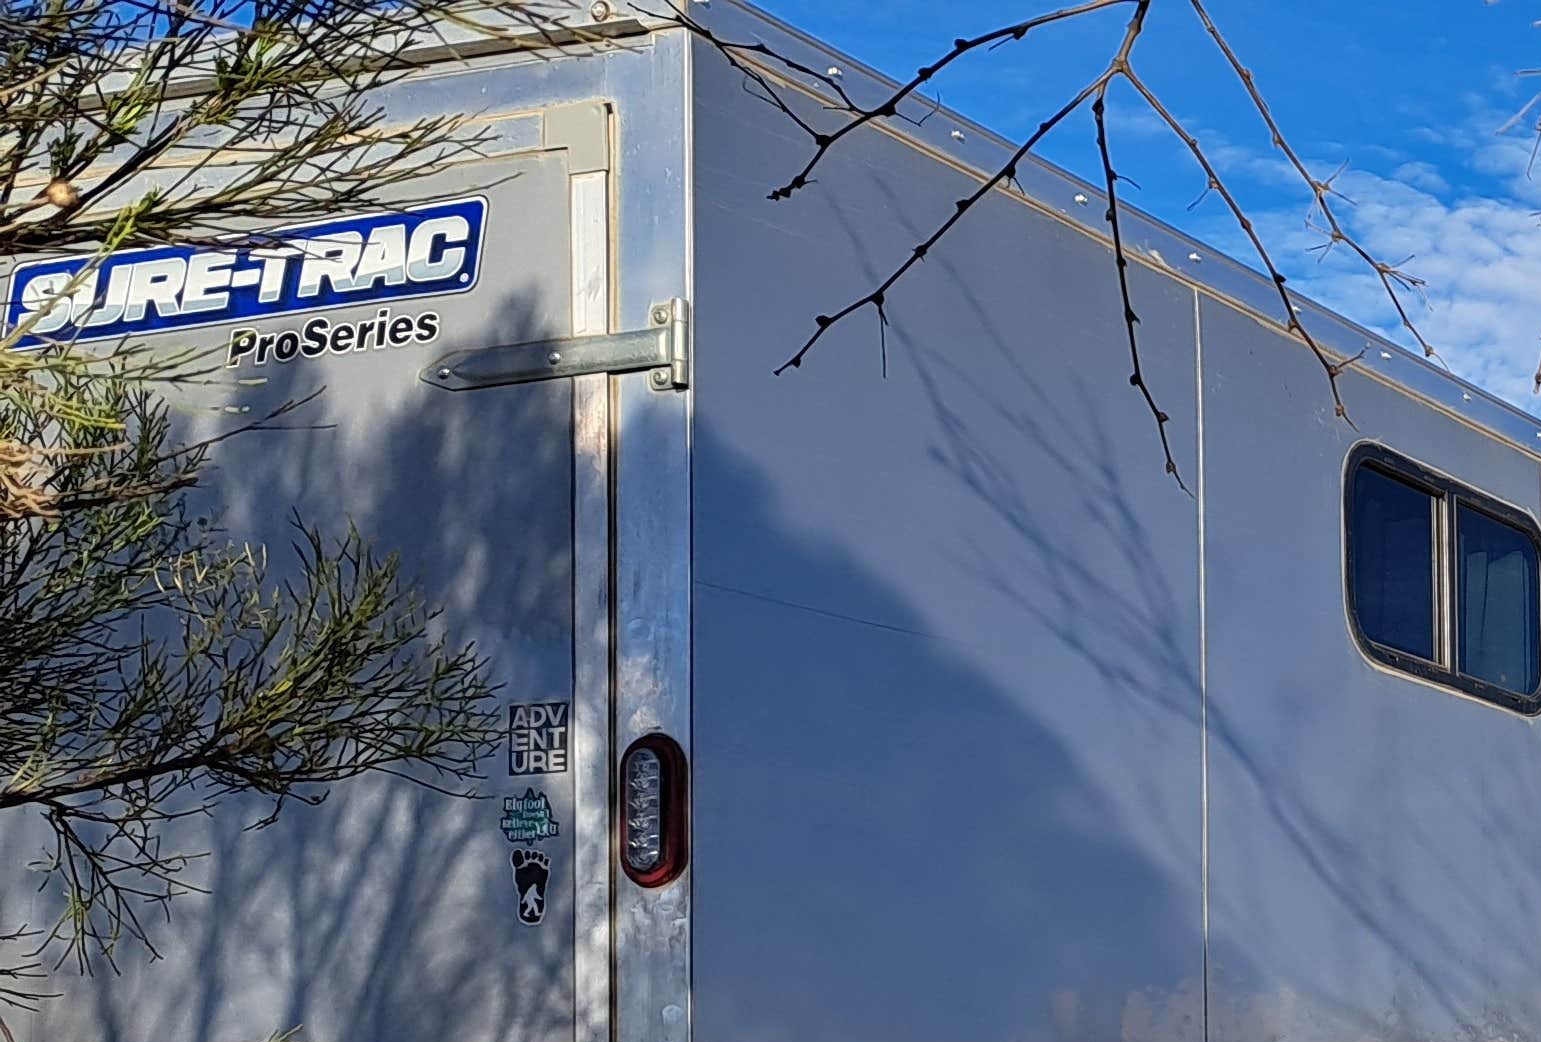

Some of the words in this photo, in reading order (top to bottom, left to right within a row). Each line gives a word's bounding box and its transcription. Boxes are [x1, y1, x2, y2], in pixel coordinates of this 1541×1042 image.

[18, 215, 471, 334] SURE-TRAC
[227, 309, 441, 368] ProSeries
[512, 704, 567, 729] ADV
[512, 727, 567, 751] ENT
[512, 750, 567, 773] URE
